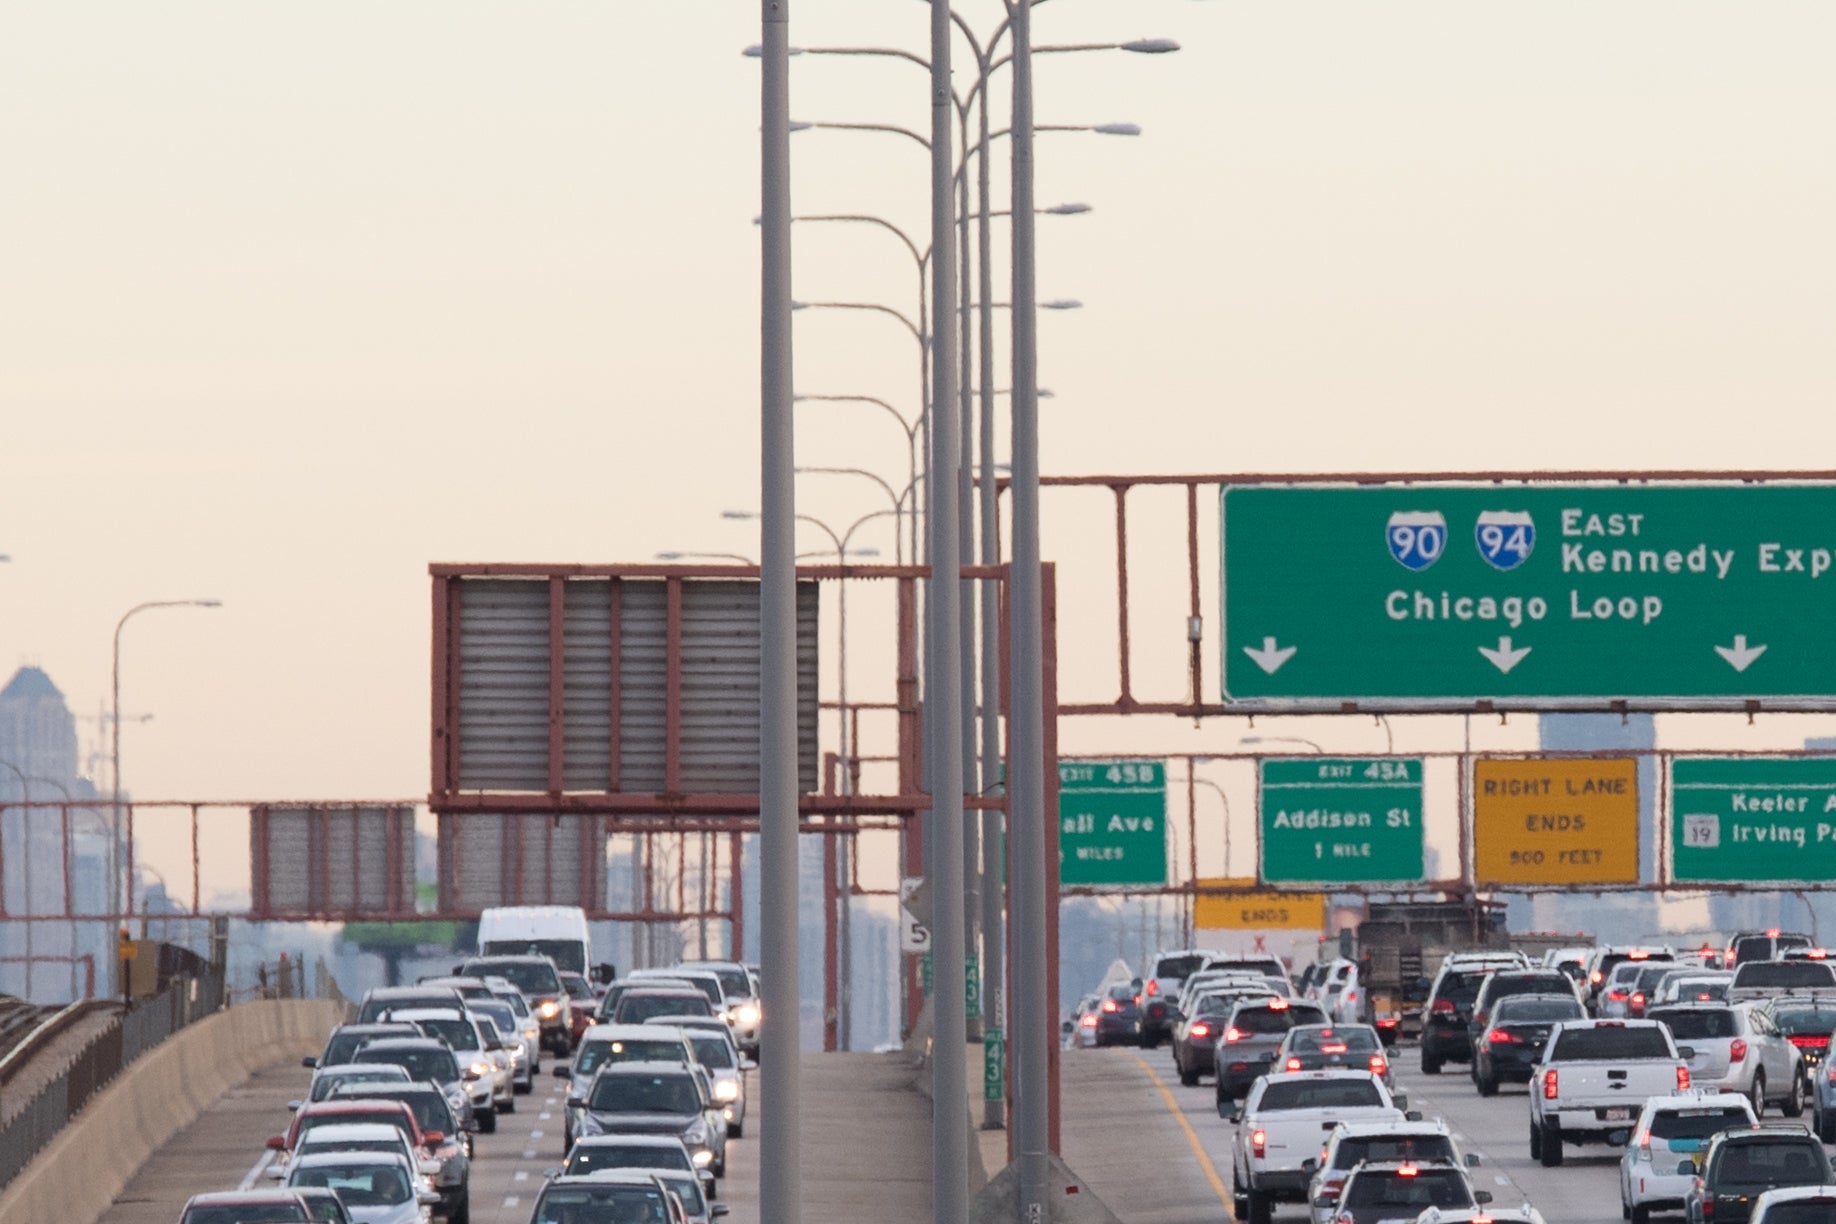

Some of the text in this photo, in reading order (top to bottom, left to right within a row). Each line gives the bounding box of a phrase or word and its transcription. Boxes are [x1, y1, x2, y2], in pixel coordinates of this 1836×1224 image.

[1562, 509, 1643, 535] EAST
[1392, 524, 1440, 560] 90
[1480, 524, 1528, 560] 94
[1563, 544, 1734, 578] Kennedy
[1387, 590, 1662, 627] Chicago Loop
[1060, 765, 1154, 783] EXIT 45B
[1319, 762, 1408, 779] EXIT 45A
[1485, 779, 1627, 795] RIGHT LANE
[1733, 794, 1808, 812] Keeler
[1108, 815, 1153, 831] Ave
[1274, 808, 1409, 828] Addison St
[1526, 815, 1585, 832] ENDS
[1691, 827, 1711, 843] 19
[1734, 824, 1805, 847] Irving
[1077, 848, 1122, 859] MILES
[1314, 842, 1369, 858] 1 MILE
[1559, 850, 1602, 864] FEET
[1241, 909, 1288, 922] ENDS
